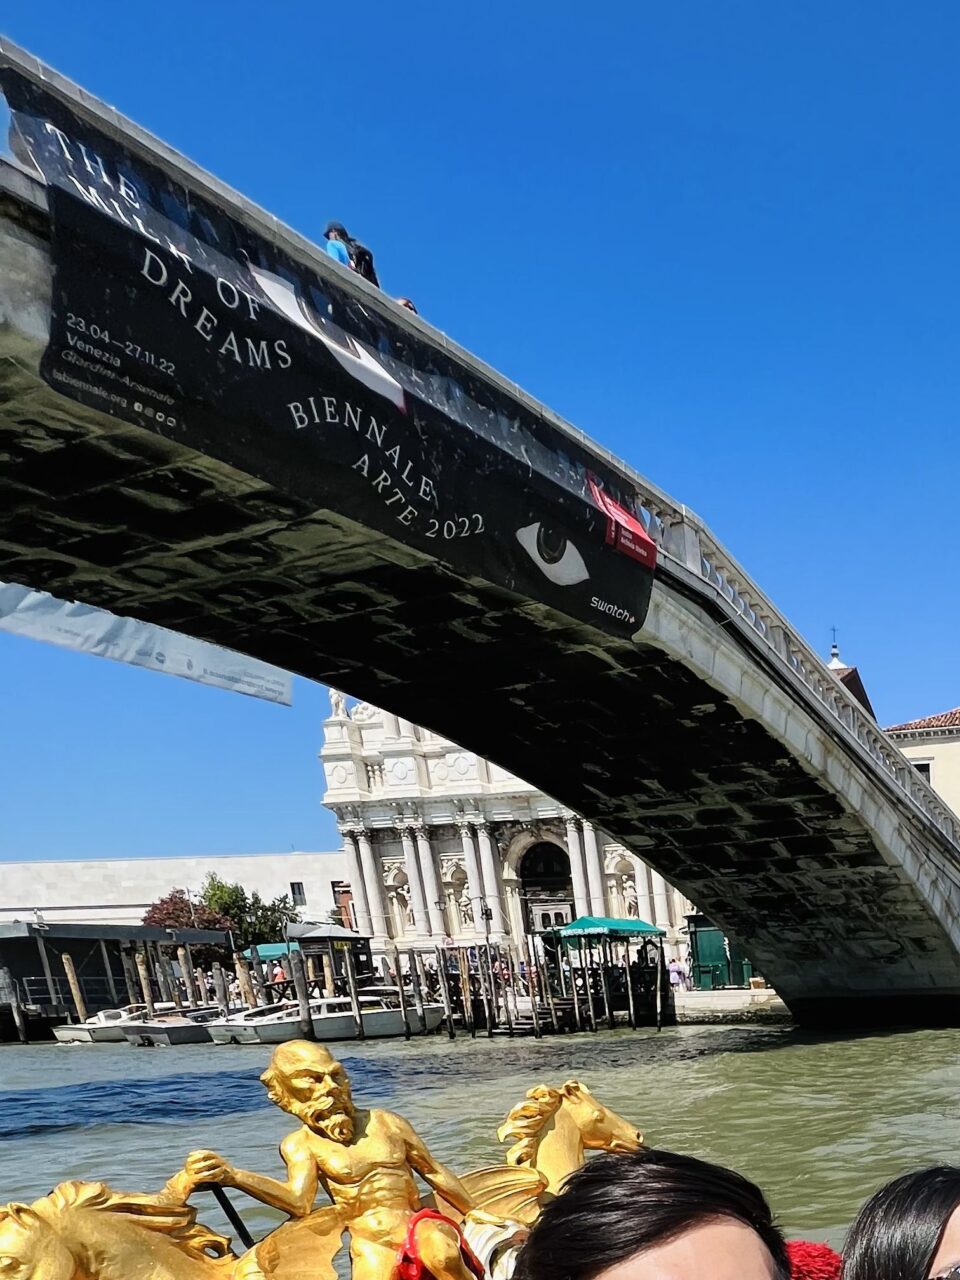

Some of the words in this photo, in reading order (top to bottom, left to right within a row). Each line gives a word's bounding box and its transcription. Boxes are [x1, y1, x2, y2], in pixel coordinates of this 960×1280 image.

[45, 122, 140, 209] THE
[67, 174, 193, 274] MILK
[217, 277, 261, 321] OF
[66, 331, 121, 368] Venezia
[140, 247, 292, 370] DREAMS
[287, 396, 434, 502] BIENNALE
[352, 453, 418, 526] ARTE
[425, 513, 485, 540] 2022
[590, 596, 630, 622] swatch
